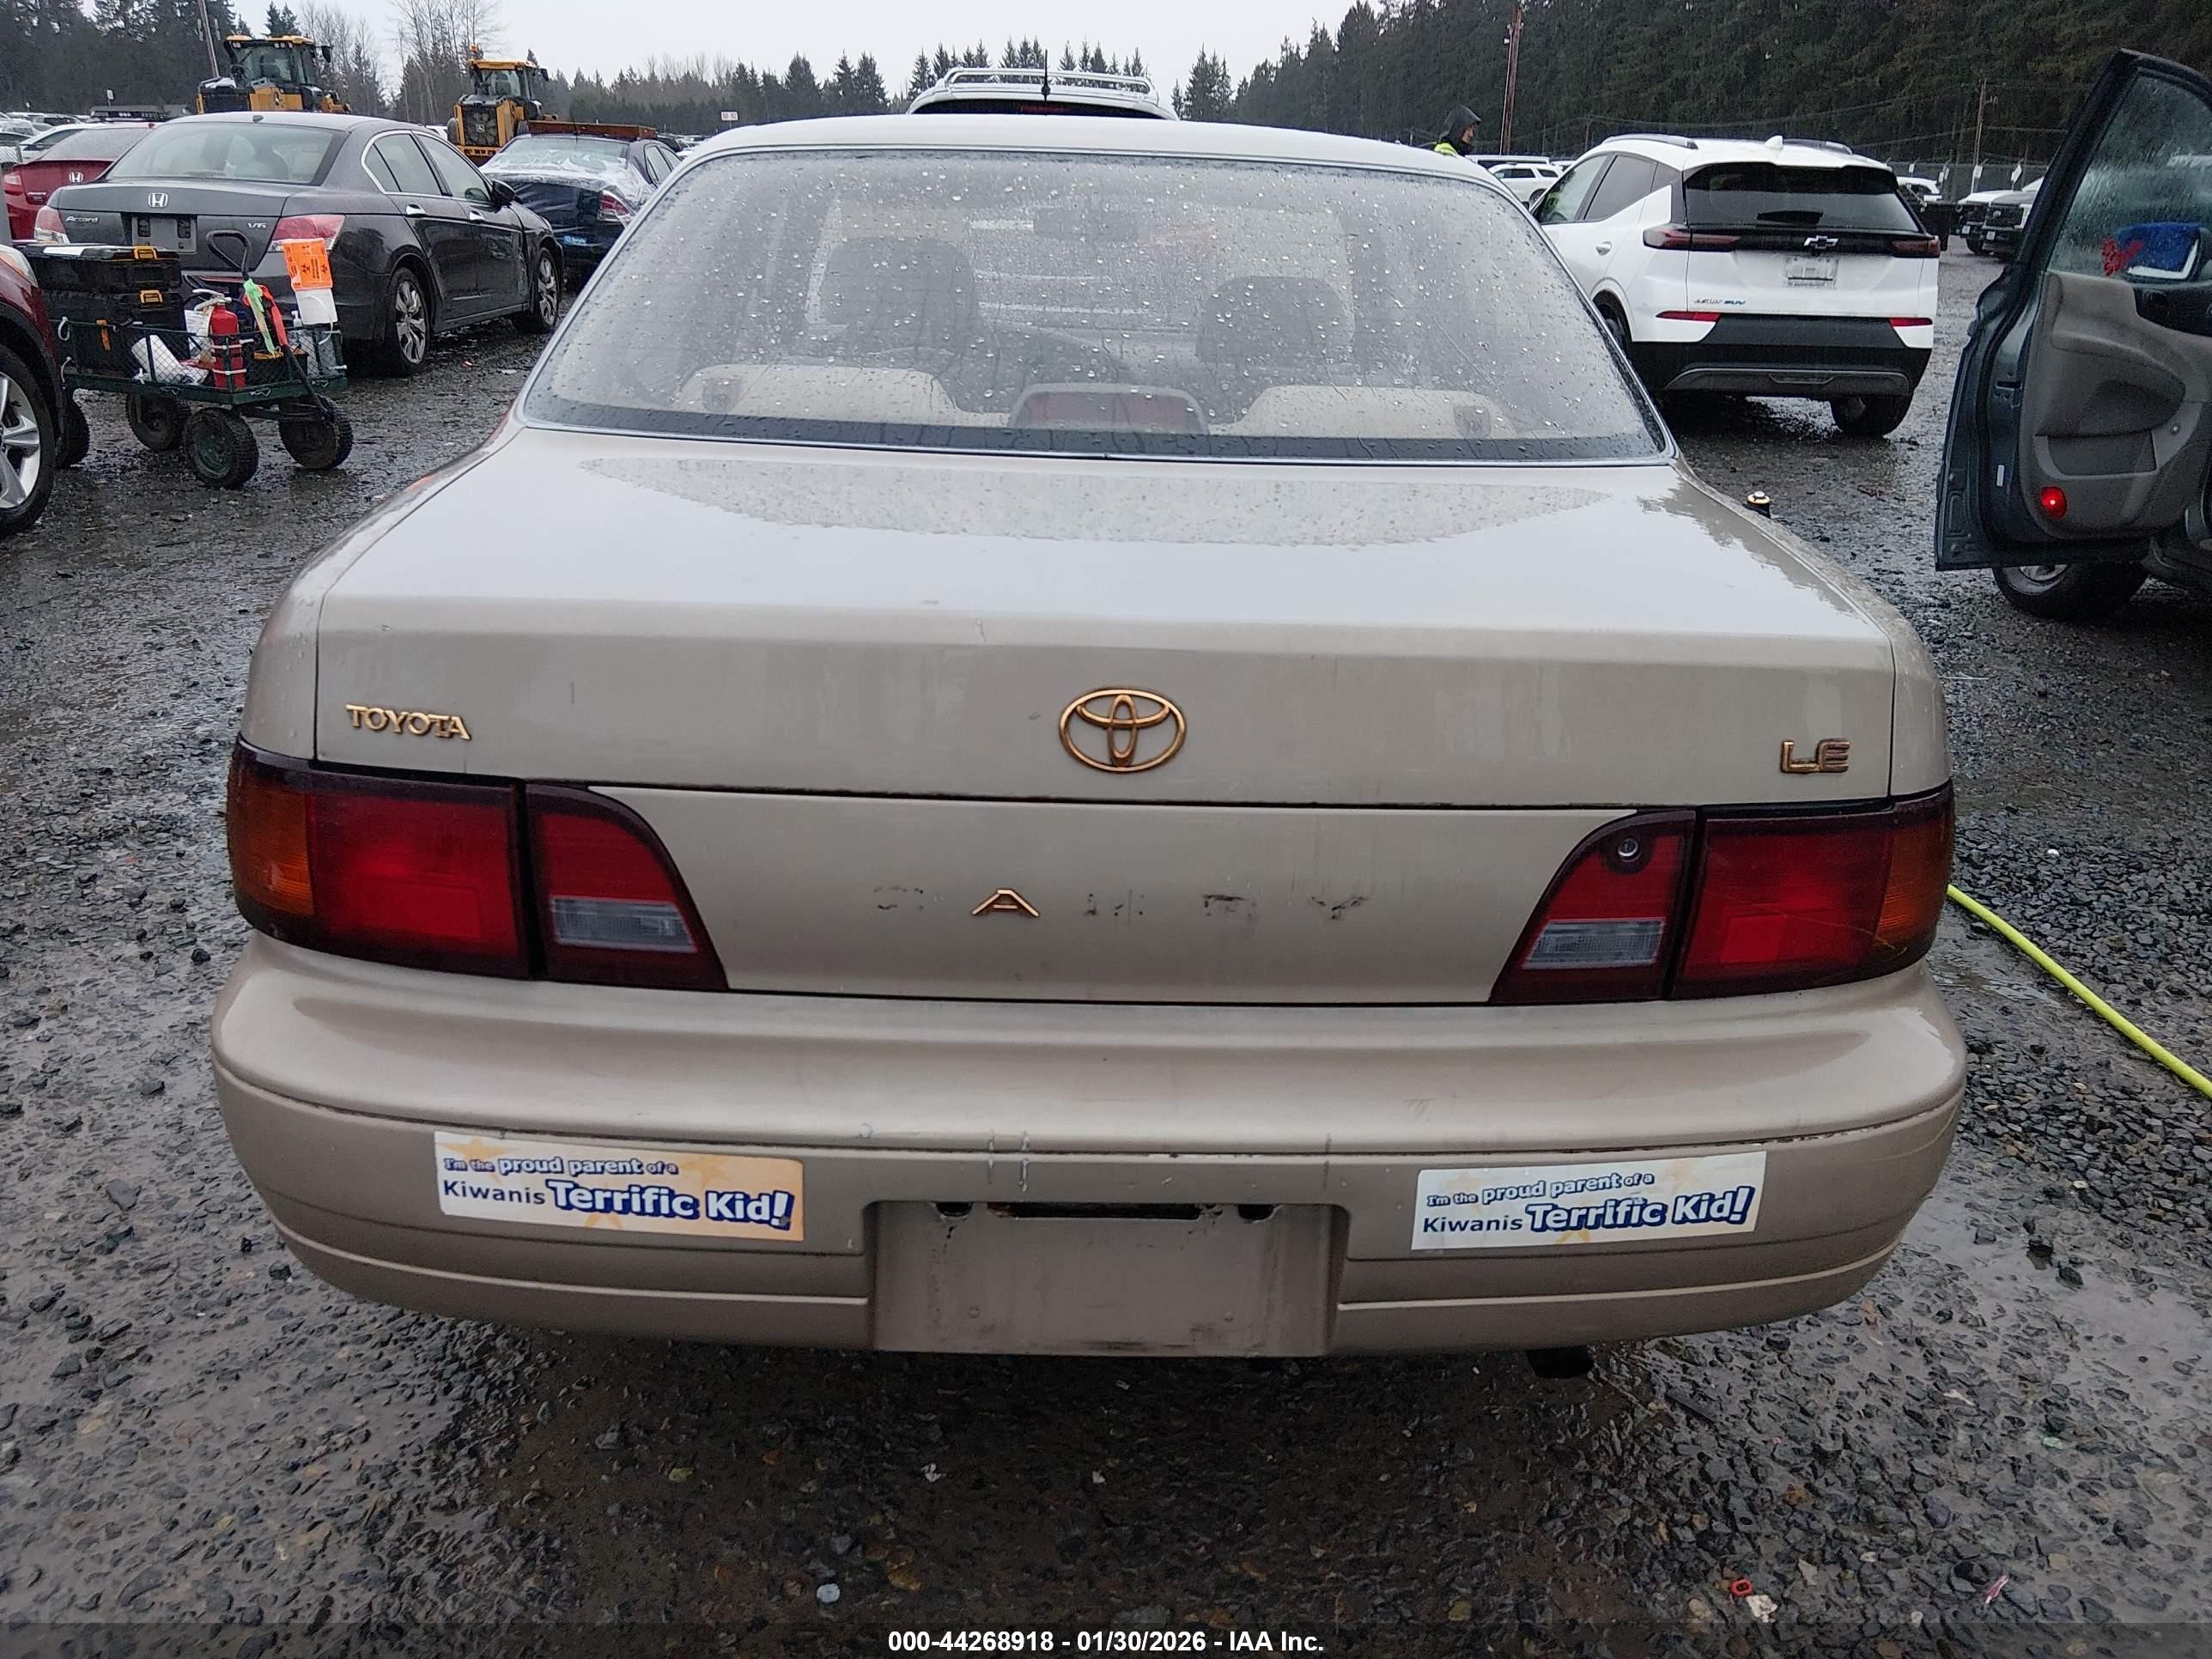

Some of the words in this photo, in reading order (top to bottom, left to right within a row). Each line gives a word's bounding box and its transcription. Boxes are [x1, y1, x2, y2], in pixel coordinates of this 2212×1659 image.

[345, 703, 471, 740] TOYOTA
[1780, 739, 1850, 774] LE
[971, 888, 1040, 918] A
[444, 1158, 468, 1171] I'm
[470, 1159, 495, 1172] the
[498, 1156, 564, 1176] proud
[568, 1158, 644, 1176] parent
[647, 1161, 665, 1174] of
[665, 1163, 679, 1175] a
[444, 1180, 545, 1205] Kiwanis
[545, 1178, 701, 1219] Terrific
[705, 1189, 794, 1231] Kid!
[1427, 1195, 1450, 1206] I'm
[1453, 1193, 1478, 1204] the
[1482, 1181, 1547, 1205] proud
[1550, 1173, 1621, 1198] parent
[1624, 1173, 1642, 1187] of
[1643, 1174, 1655, 1184] a
[1423, 1215, 1523, 1232] Kiwanis
[1525, 1197, 1668, 1231] Terrific
[1672, 1186, 1755, 1224] Kid!
